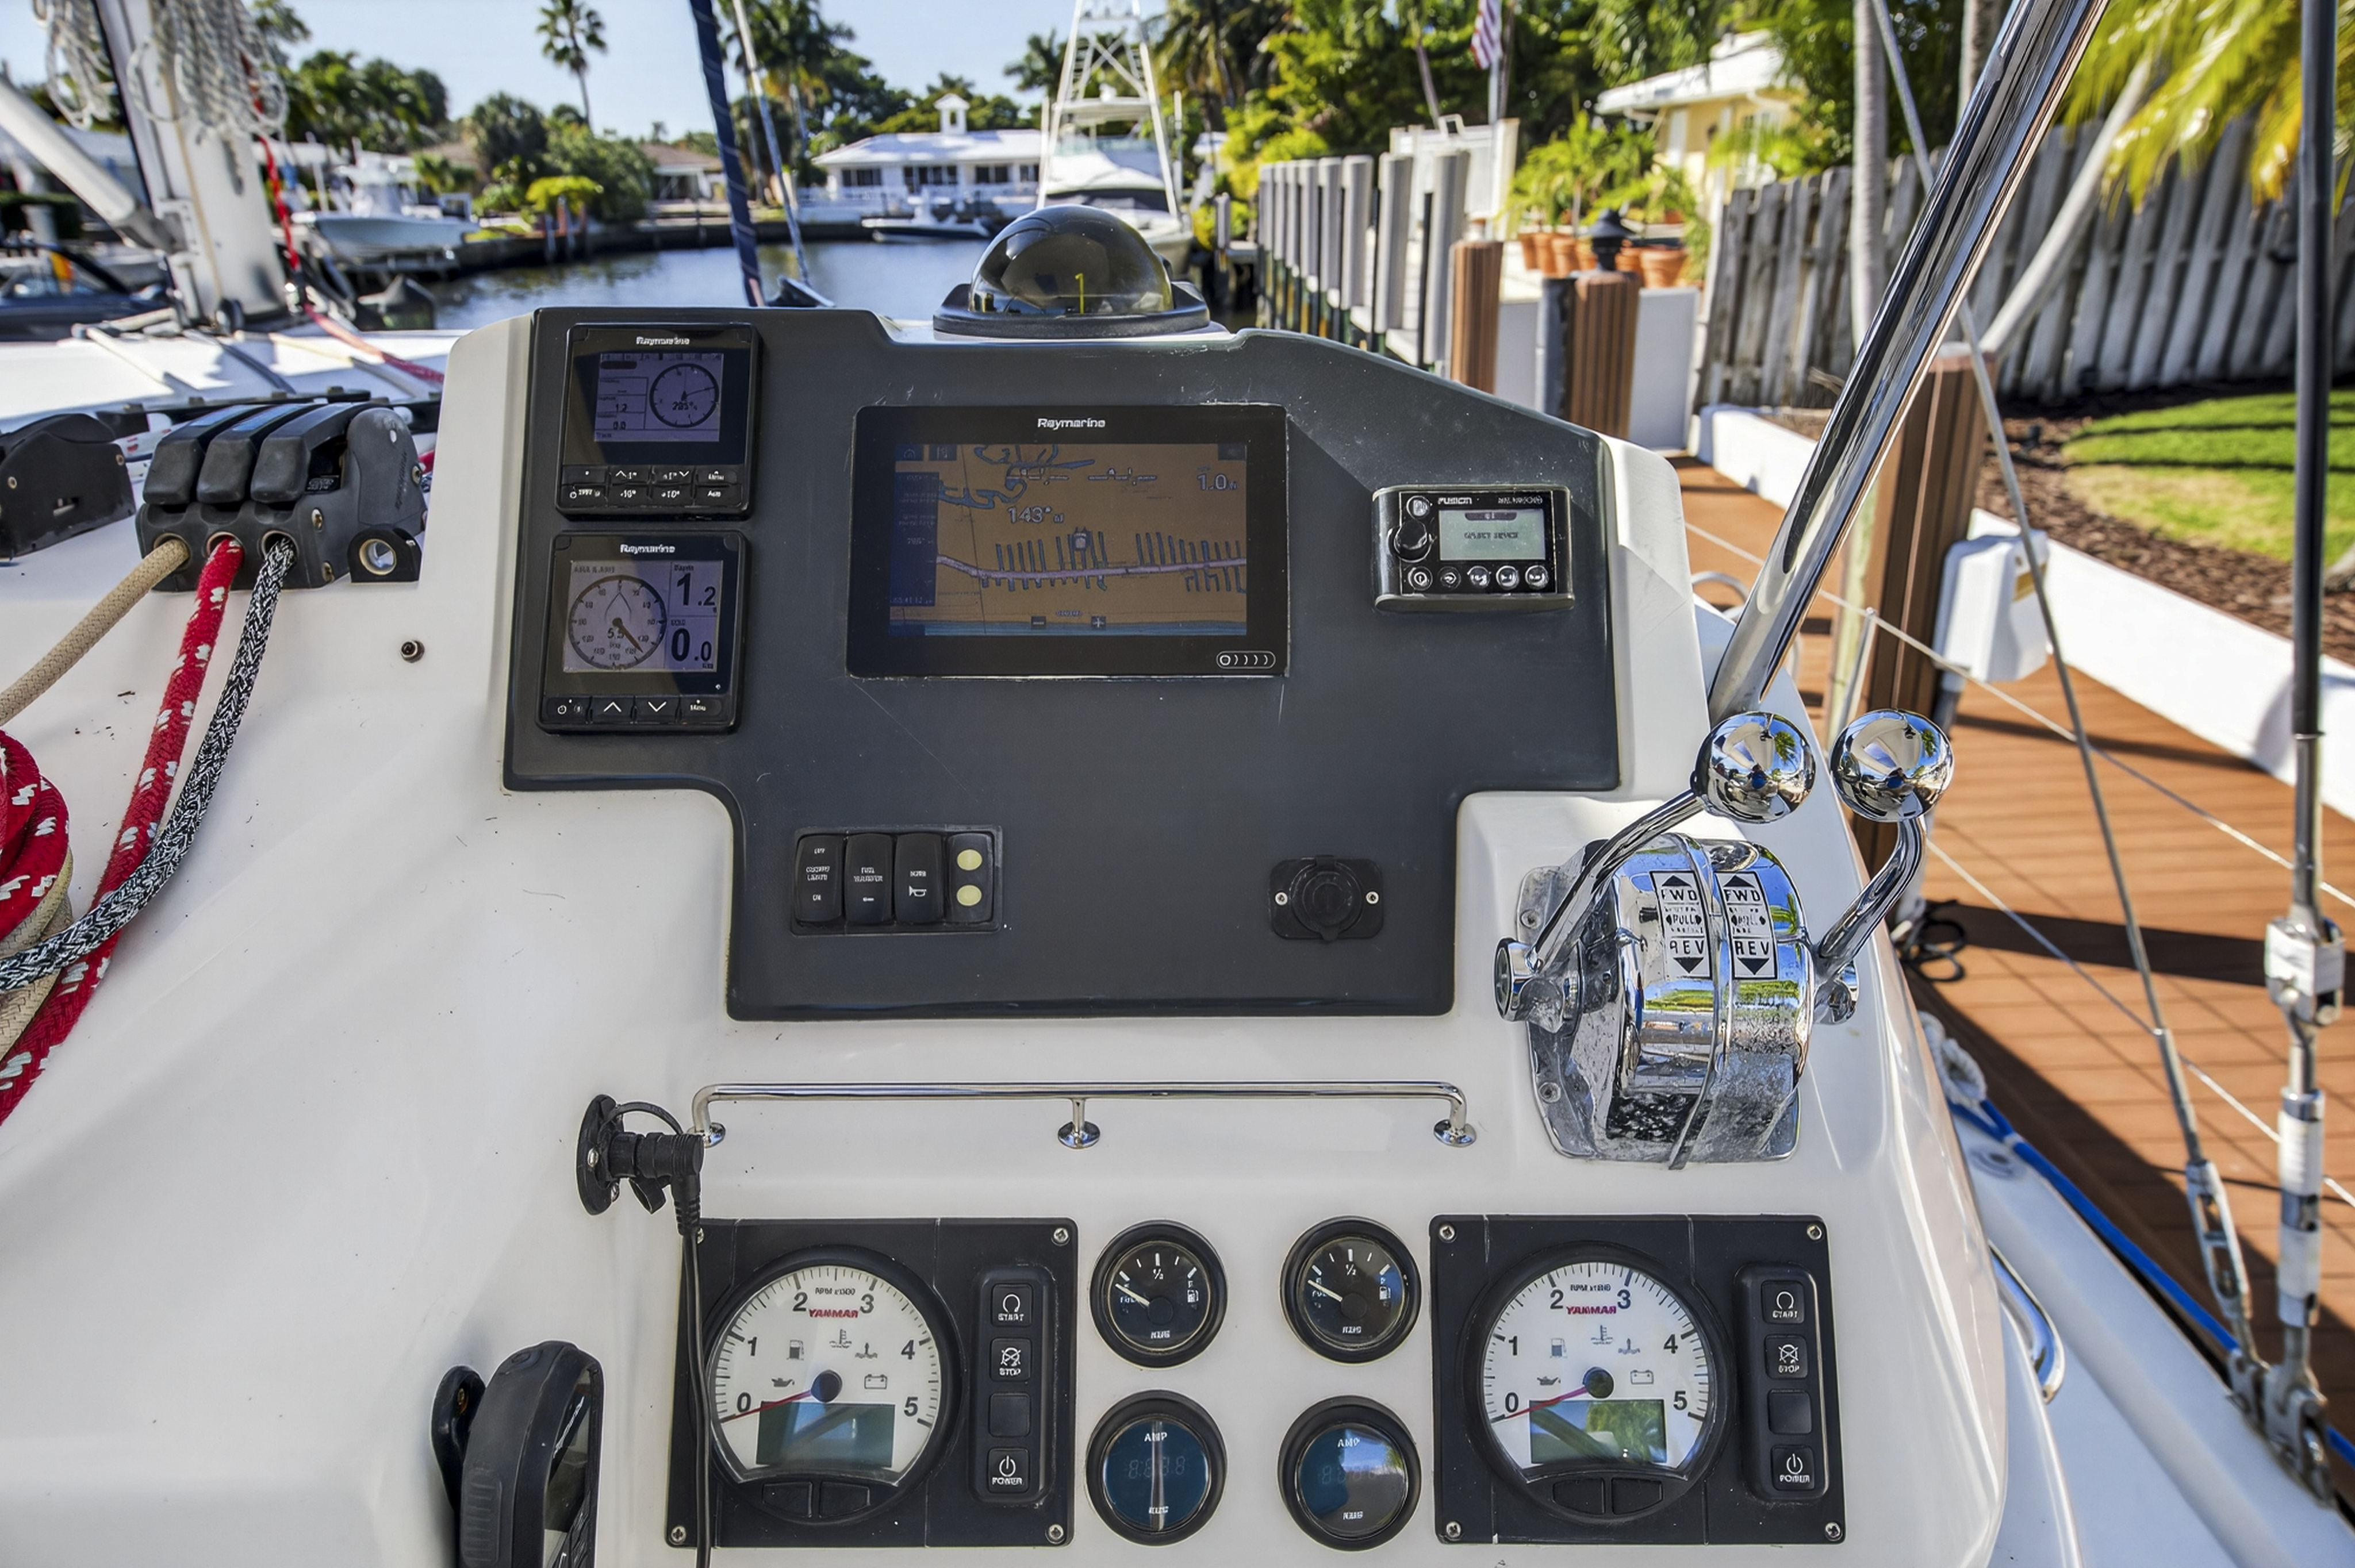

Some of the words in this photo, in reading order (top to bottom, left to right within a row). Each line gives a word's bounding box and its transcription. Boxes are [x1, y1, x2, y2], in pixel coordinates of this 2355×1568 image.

[1037, 418, 1106, 431] Raymarine
[620, 544, 675, 554] Raymarine
[672, 628, 712, 662] 0.0
[1724, 889, 1761, 901] FWD
[1670, 940, 1704, 954] REV
[1734, 940, 1769, 955] REV
[792, 1292, 808, 1312] 2
[860, 1294, 875, 1314] 3
[1550, 1289, 1564, 1309] 2
[1617, 1289, 1632, 1309] 3
[809, 1309, 858, 1319] YANMAR
[1566, 1305, 1617, 1315] YANMAR
[747, 1336, 758, 1356] 1
[901, 1339, 915, 1360] 4
[1508, 1335, 1518, 1356] 1
[1663, 1334, 1678, 1354] 4
[999, 1368, 1021, 1376] STOP
[737, 1392, 751, 1412] 0
[904, 1397, 919, 1417] 5
[1505, 1392, 1520, 1413] 0
[1673, 1390, 1687, 1411] 5
